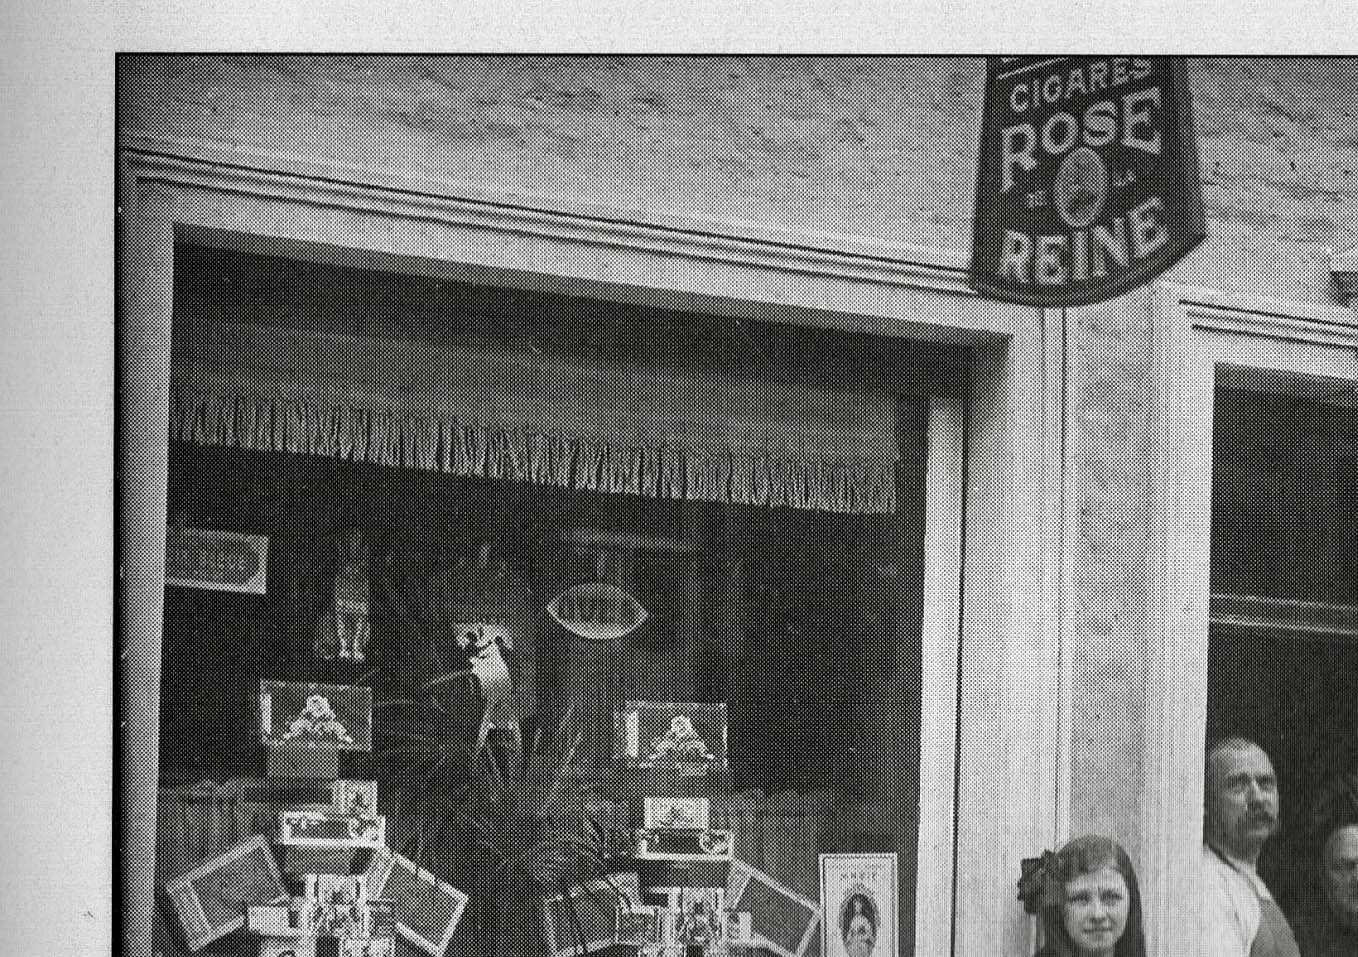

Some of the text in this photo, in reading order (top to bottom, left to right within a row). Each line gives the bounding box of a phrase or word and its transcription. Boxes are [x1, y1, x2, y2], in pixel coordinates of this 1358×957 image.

[1009, 58, 1152, 112] CIGARES
[999, 86, 1162, 194] ROSE
[997, 196, 1170, 287] REINE
